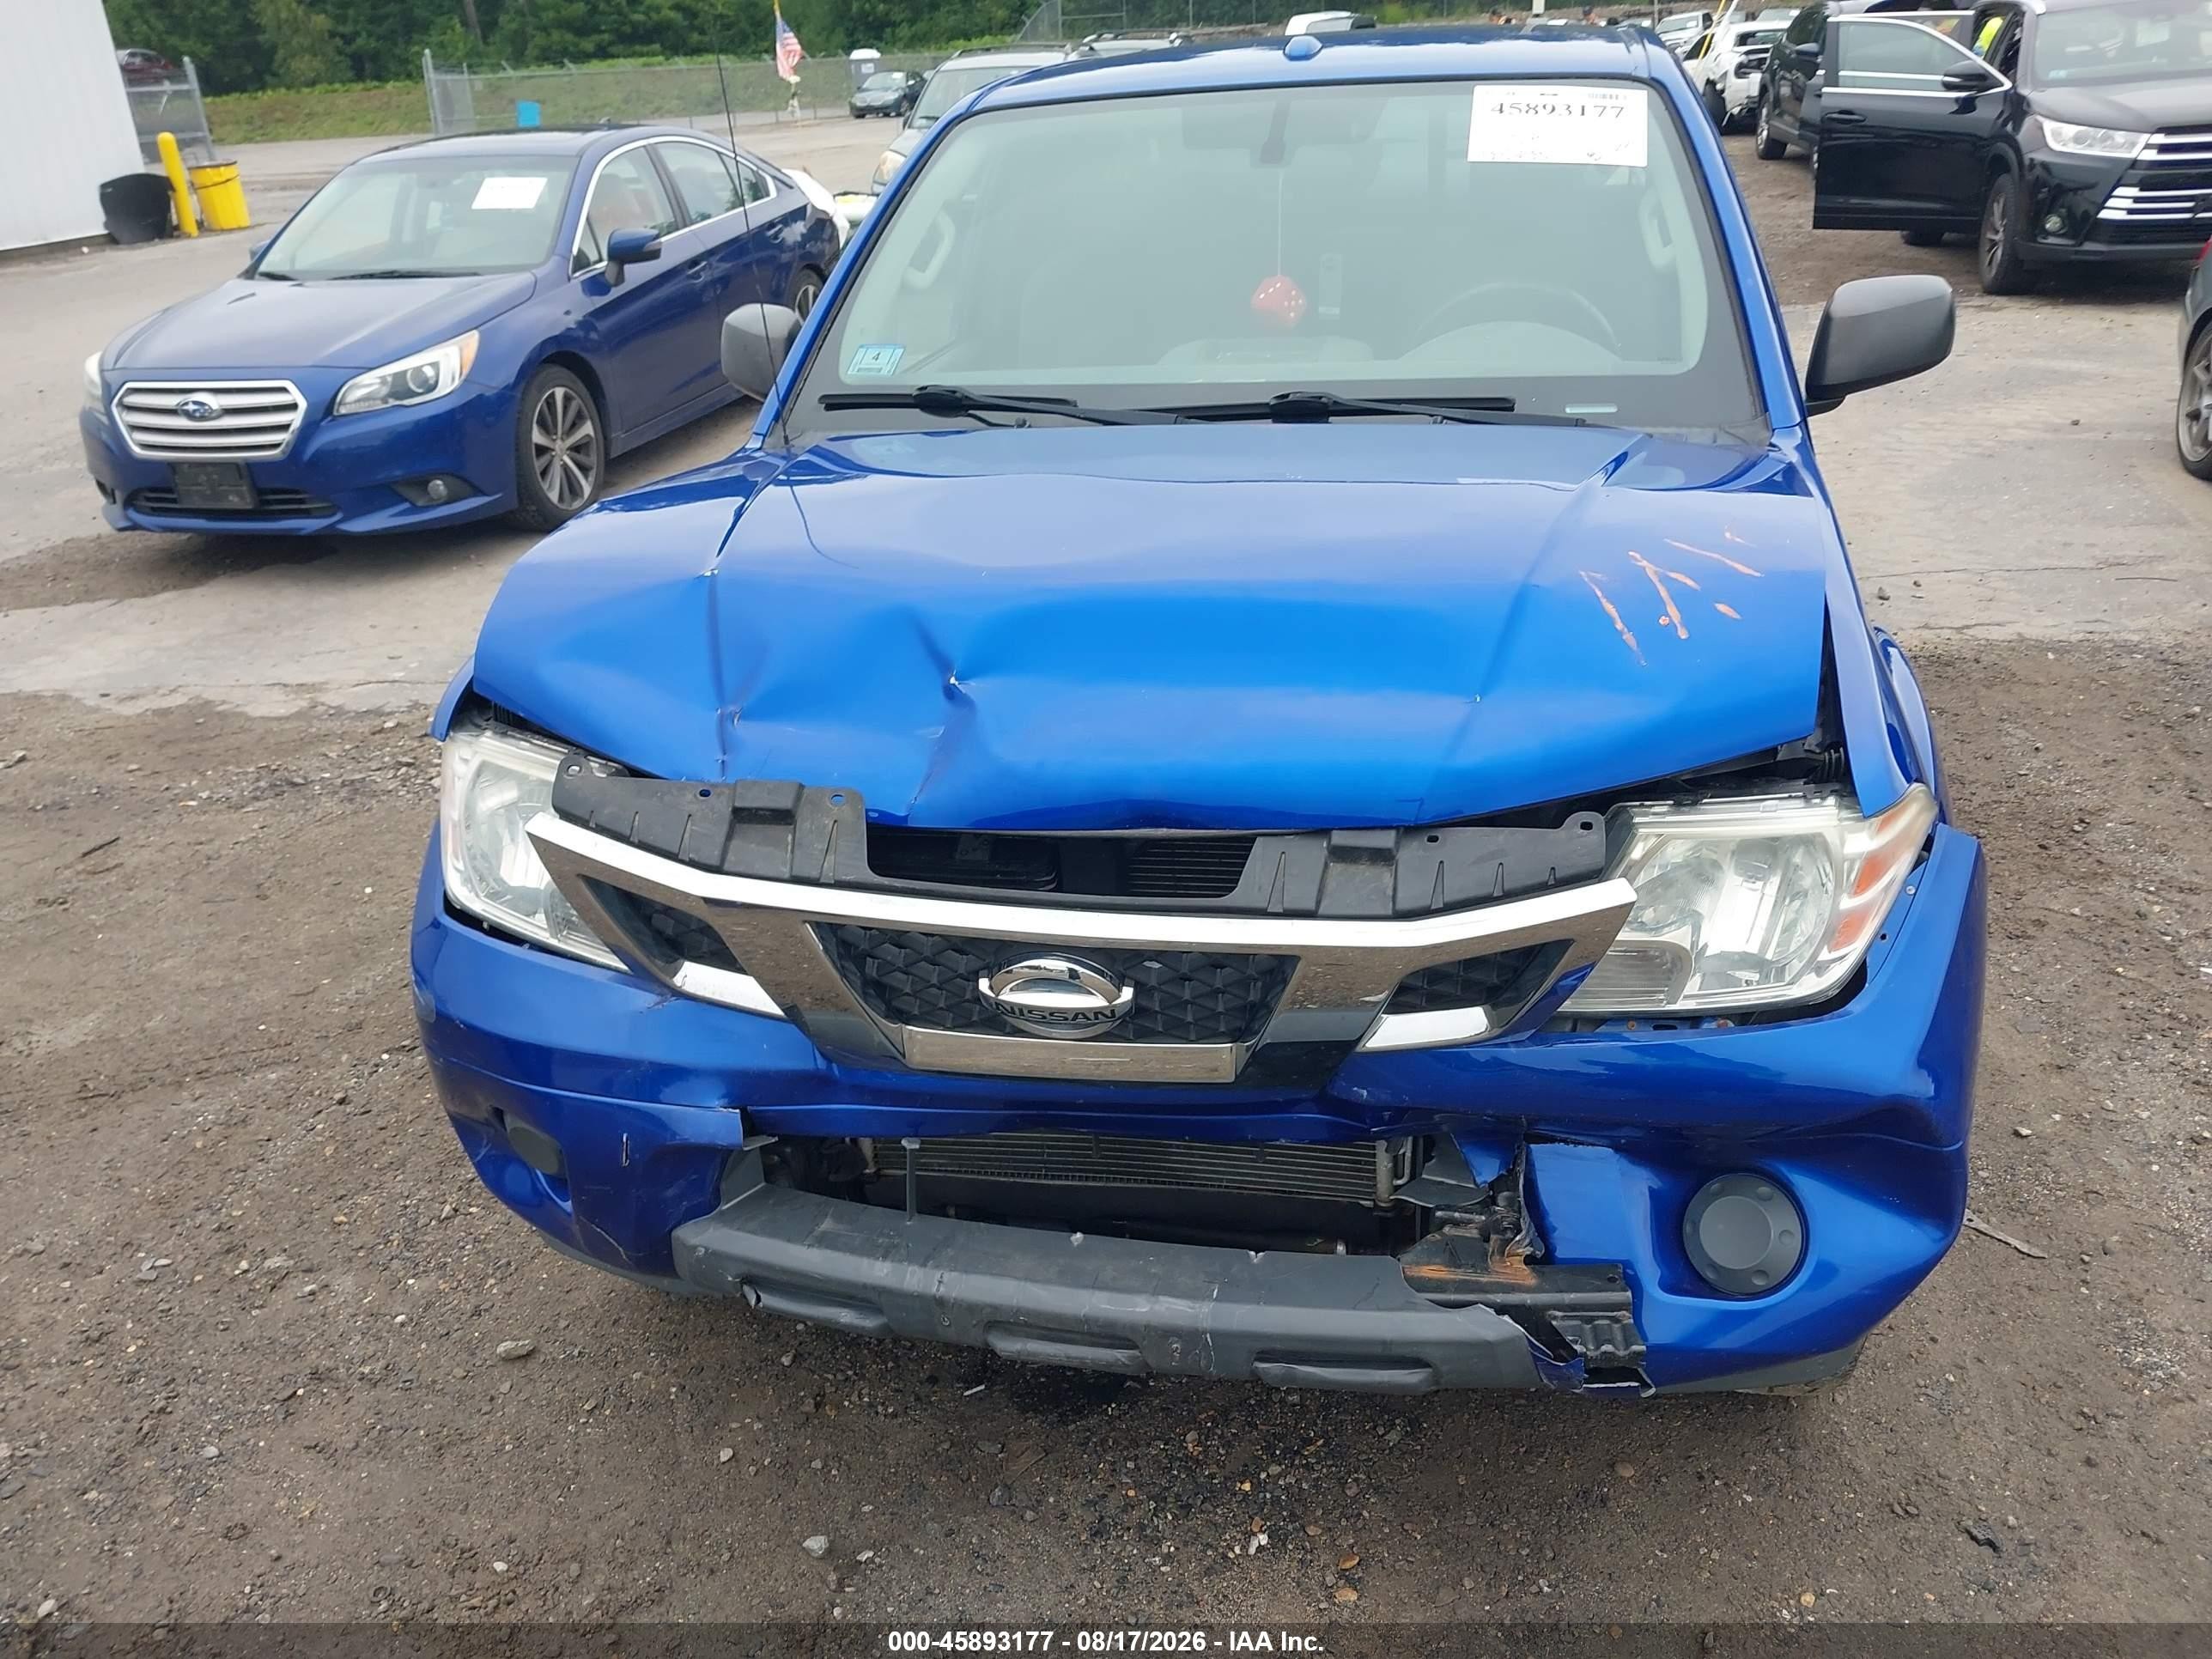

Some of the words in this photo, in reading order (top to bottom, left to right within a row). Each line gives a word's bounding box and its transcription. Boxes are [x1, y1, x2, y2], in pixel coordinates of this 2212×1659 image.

[1491, 102, 1625, 118] 45893177
[872, 351, 881, 362] 4
[994, 1000, 1117, 1022] NISSAN
